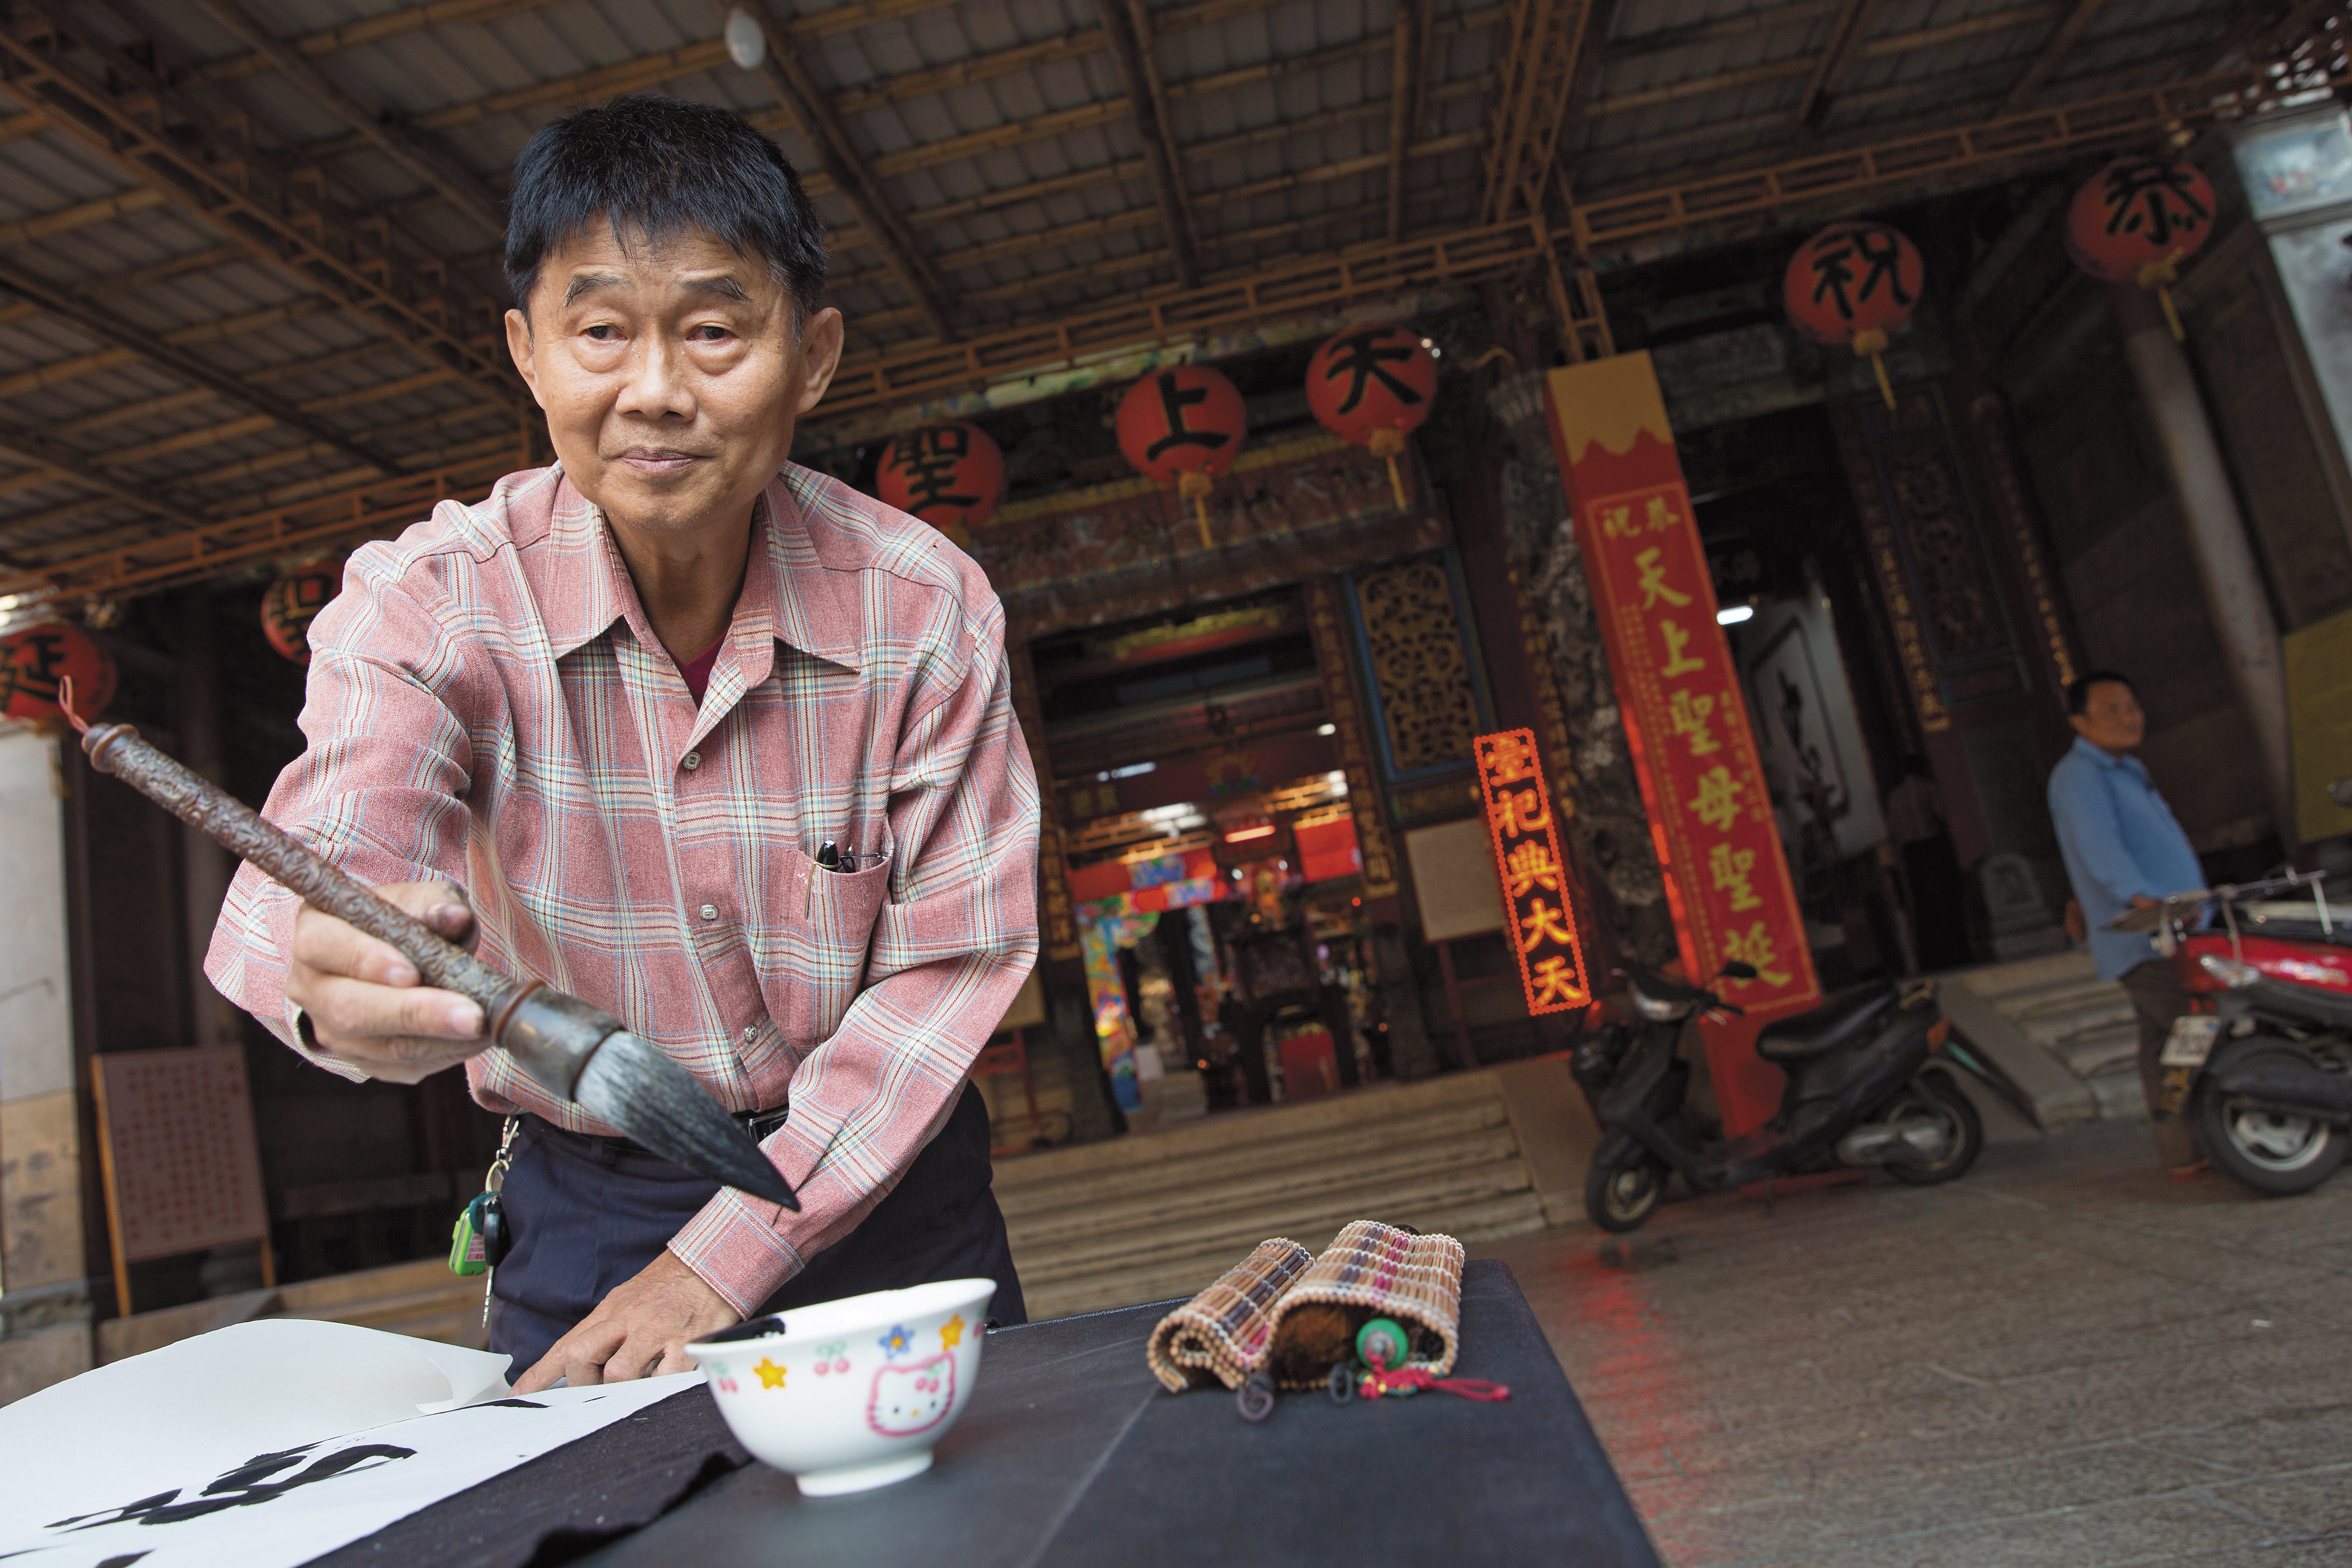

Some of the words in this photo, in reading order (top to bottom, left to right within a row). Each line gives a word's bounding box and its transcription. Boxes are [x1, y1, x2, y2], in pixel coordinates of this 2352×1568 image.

[2104, 159, 2210, 245] 恭
[1813, 230, 1913, 319] 祝
[1326, 326, 1422, 416] 天
[1147, 371, 1230, 462] 上
[889, 421, 980, 515] 聖
[1485, 735, 1586, 1006] 臺祀典大天
